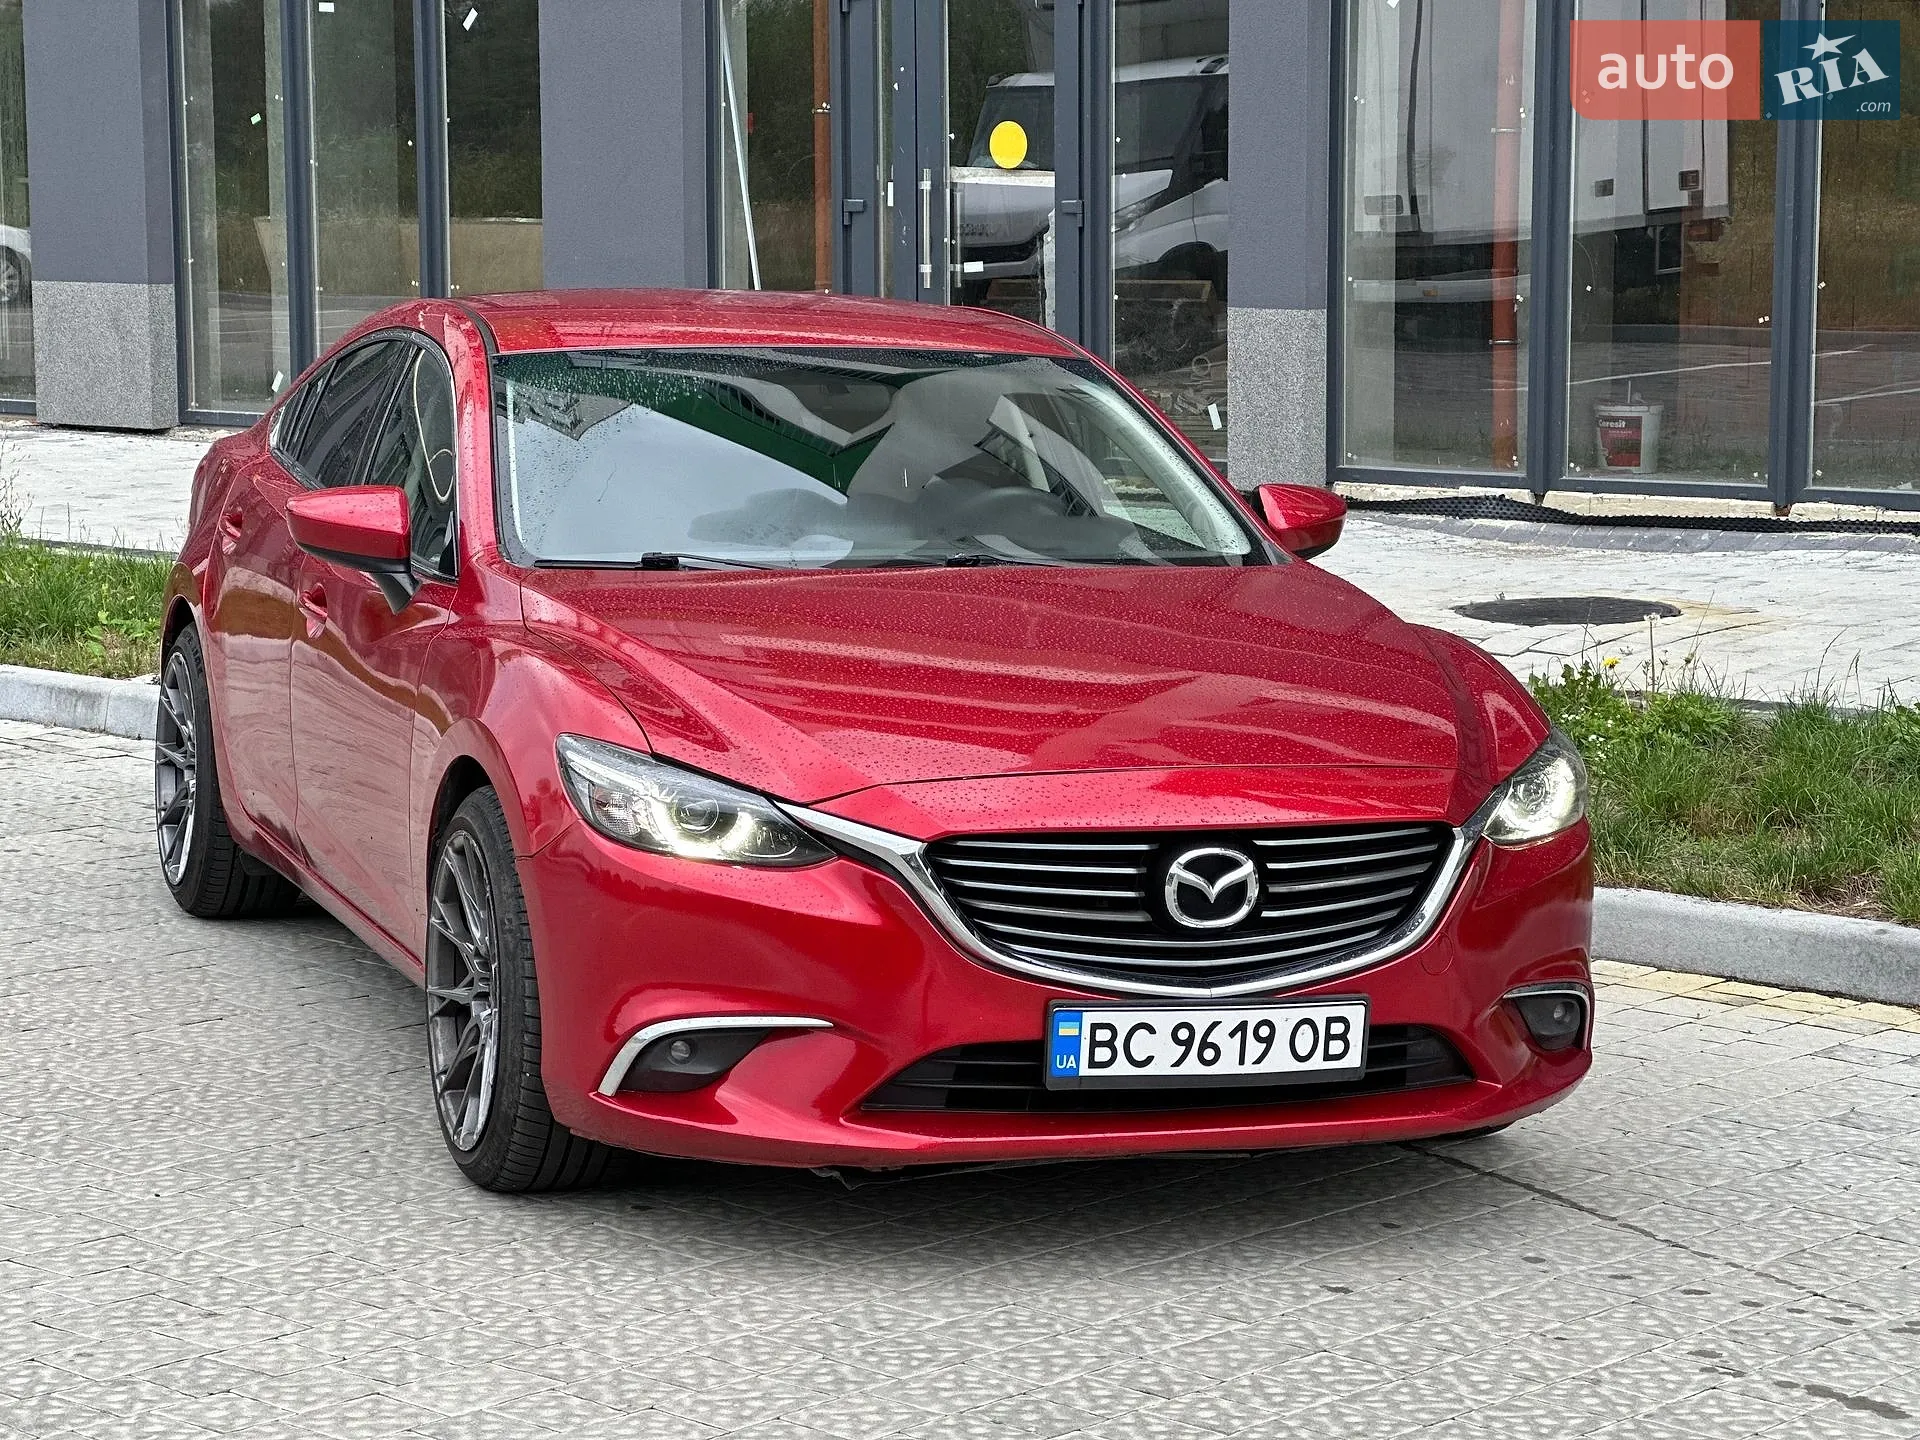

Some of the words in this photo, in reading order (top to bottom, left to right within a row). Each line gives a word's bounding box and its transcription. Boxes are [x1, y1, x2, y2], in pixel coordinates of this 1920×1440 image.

[1088, 1022, 1157, 1069] BC
[1170, 1019, 1277, 1067] 9619
[1288, 1015, 1352, 1062] OB
[1056, 1055, 1077, 1069] UA
